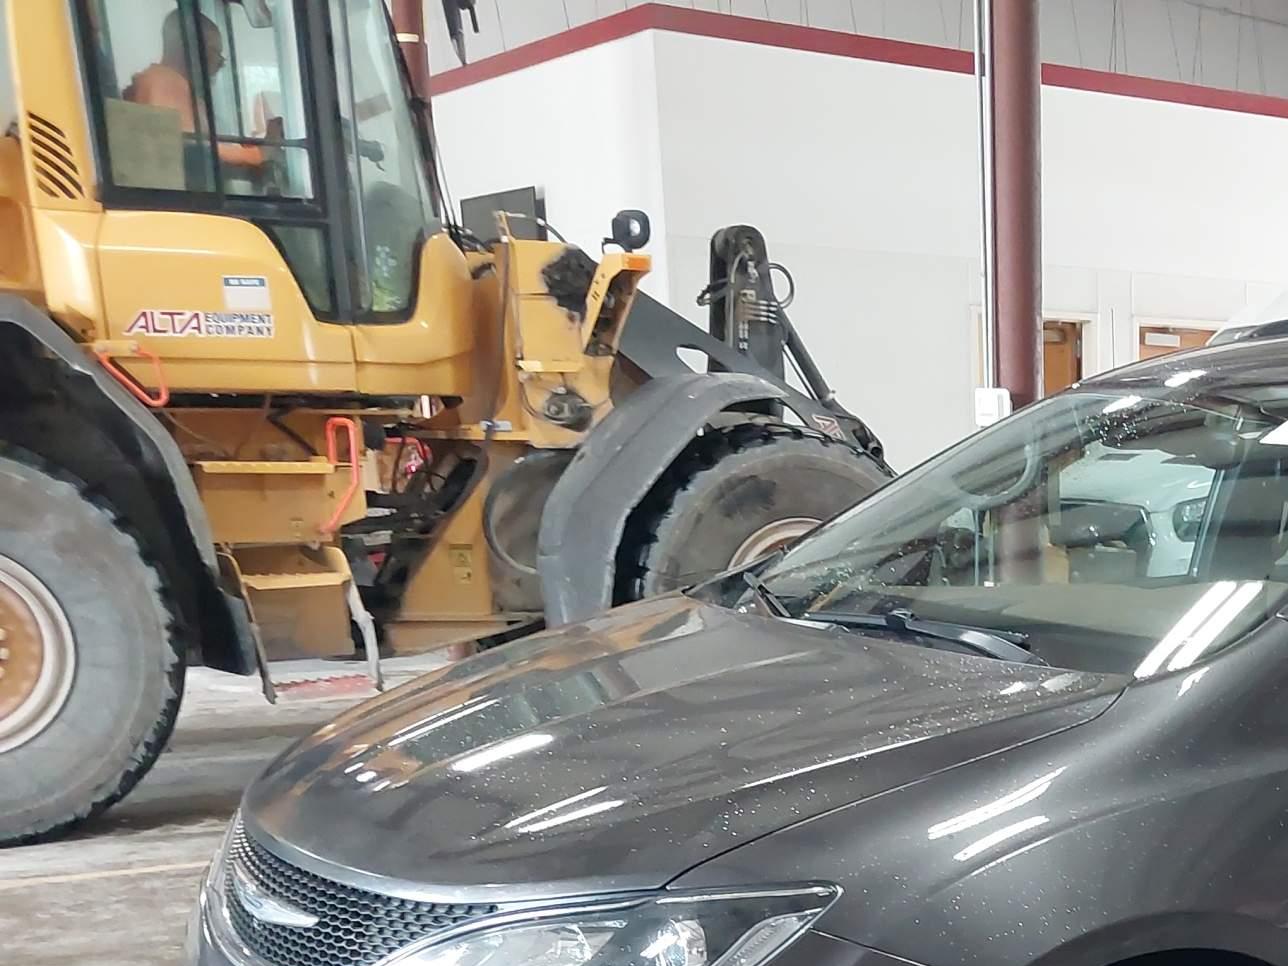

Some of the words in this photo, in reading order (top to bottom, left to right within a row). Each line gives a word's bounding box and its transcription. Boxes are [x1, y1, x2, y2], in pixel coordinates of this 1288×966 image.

[125, 311, 202, 334] ALTA
[205, 312, 272, 324] EQUIPMENT
[205, 325, 272, 336] COMPANY
